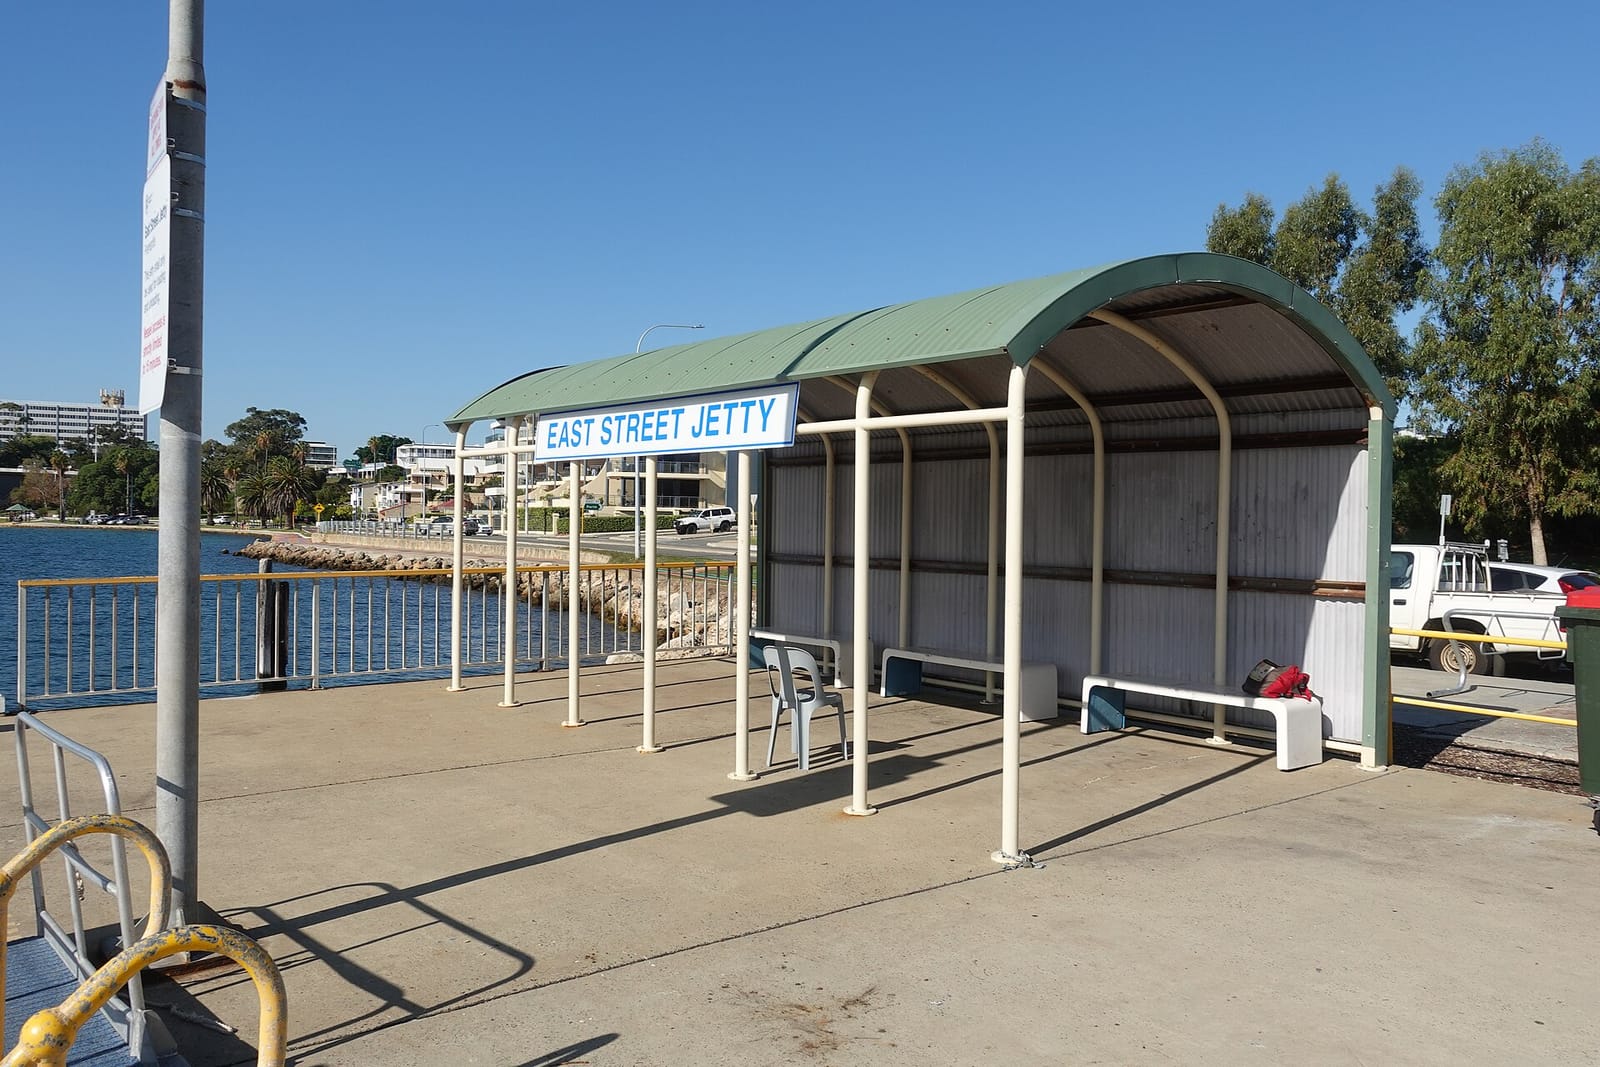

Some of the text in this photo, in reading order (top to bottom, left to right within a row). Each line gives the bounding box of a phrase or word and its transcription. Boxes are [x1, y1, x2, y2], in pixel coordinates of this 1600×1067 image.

[547, 398, 776, 449] EAST STREET JETTY
